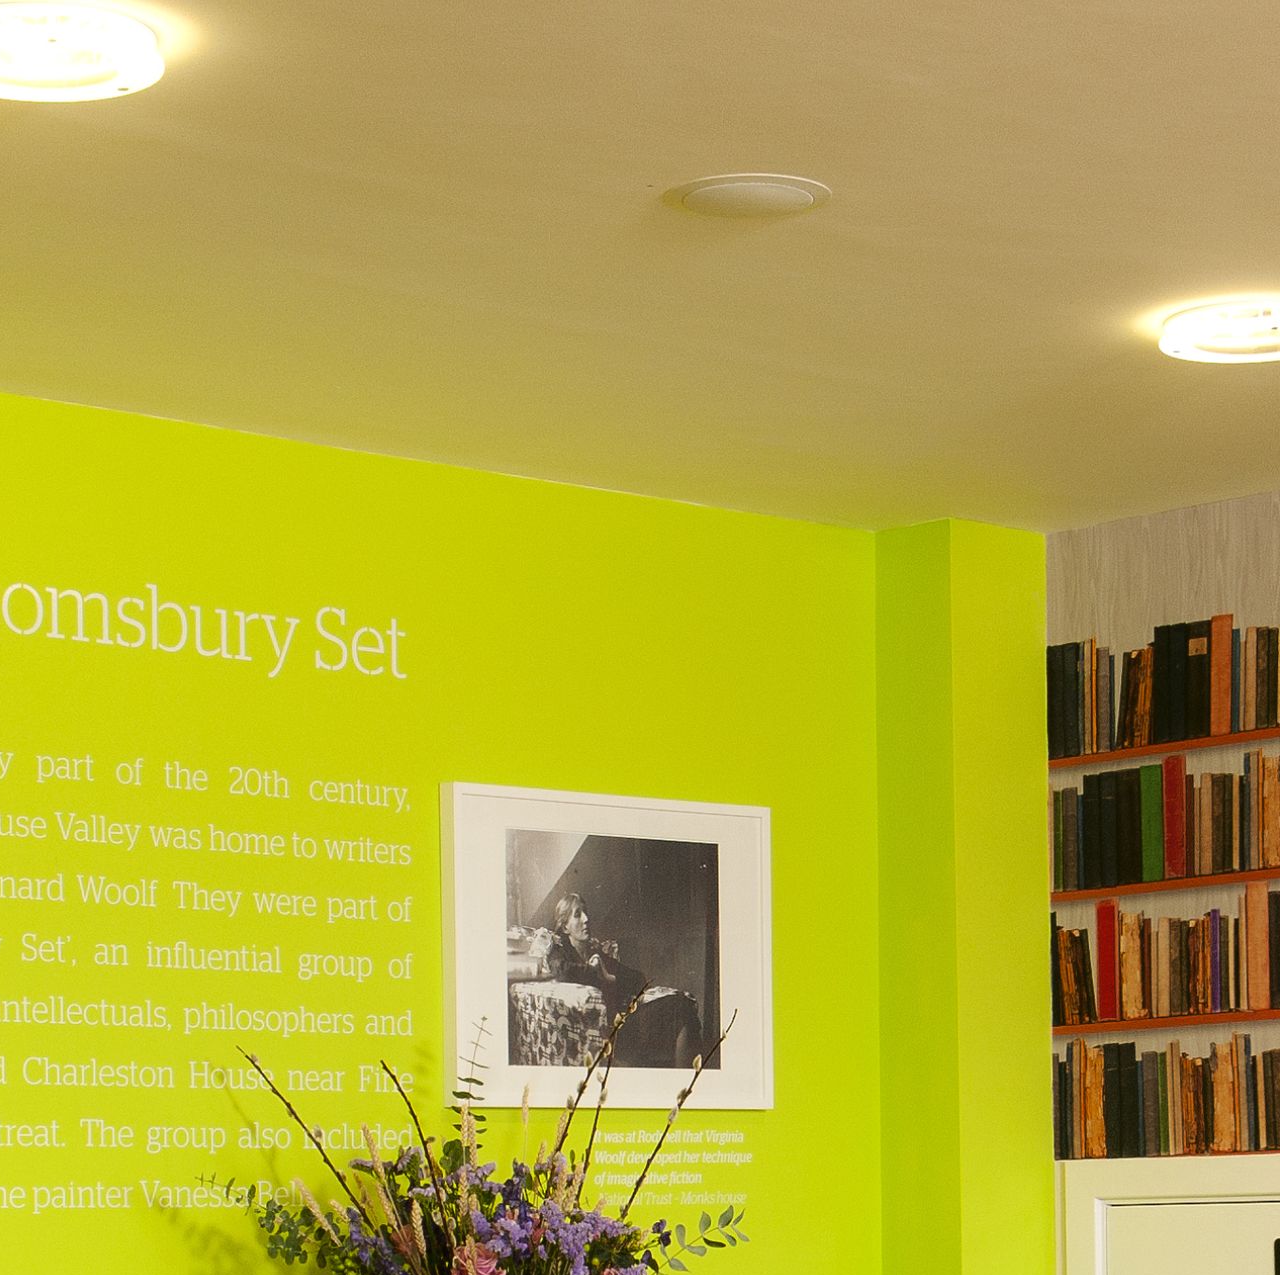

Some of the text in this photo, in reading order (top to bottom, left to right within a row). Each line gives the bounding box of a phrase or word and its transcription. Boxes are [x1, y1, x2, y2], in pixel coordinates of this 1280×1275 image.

[315, 606, 407, 679] Set
[36, 754, 94, 784] part
[115, 757, 144, 786] of
[164, 761, 208, 791] the
[229, 765, 290, 798] 20th
[308, 779, 411, 813] century,
[54, 811, 142, 851] Valley
[149, 824, 203, 850] was
[208, 823, 286, 857] home
[291, 832, 319, 859] to
[323, 837, 413, 865] writers
[76, 874, 158, 907] Woolf
[172, 880, 243, 917] They
[252, 892, 317, 916] were
[327, 896, 378, 924] part
[387, 896, 413, 923] of
[93, 943, 128, 966] an
[147, 940, 282, 973] influential
[298, 952, 374, 983] group
[388, 952, 414, 980] of
[183, 1001, 355, 1038] philosophers
[365, 1009, 413, 1036] and
[23, 1056, 175, 1088] Charleston
[189, 1060, 275, 1091] House
[288, 1070, 346, 1092] near
[80, 1118, 134, 1148] The
[146, 1126, 227, 1155] group
[238, 1121, 292, 1150] also
[604, 1132, 624, 1143] was
[626, 1131, 635, 1143] at
[638, 1131, 681, 1143] Rodell
[683, 1131, 703, 1143] that
[706, 1130, 744, 1145] Virginia
[595, 1151, 752, 1166] Woolf devoped her technique
[32, 1181, 133, 1214] painter
[257, 1179, 304, 1208] Bel
[594, 1173, 702, 1187] of imagiative fiction
[598, 1192, 642, 1205] Natioal
[647, 1193, 672, 1205] Trust
